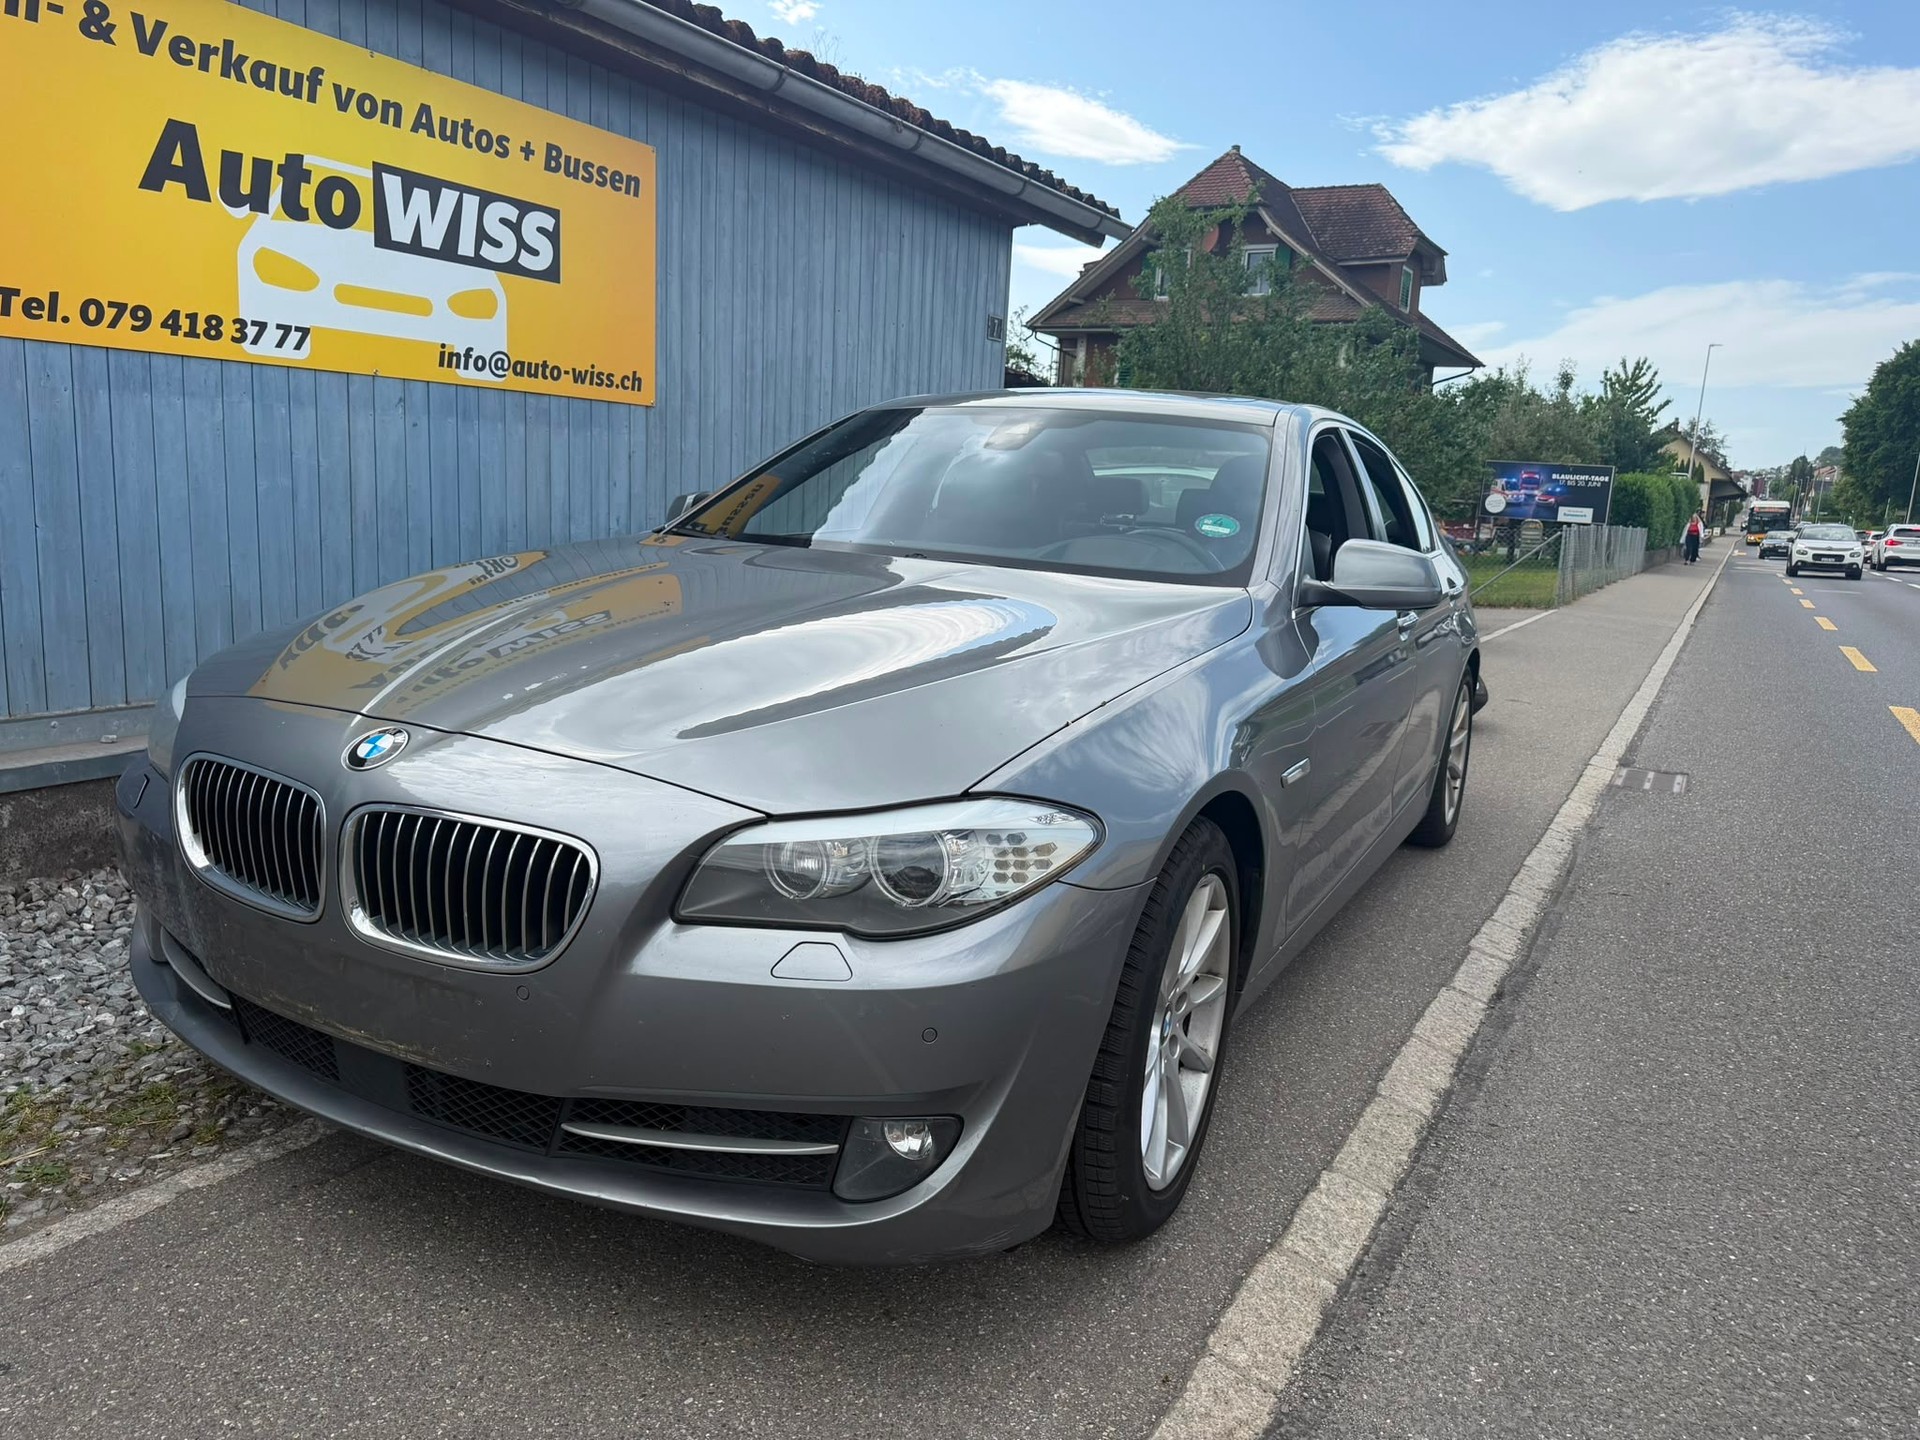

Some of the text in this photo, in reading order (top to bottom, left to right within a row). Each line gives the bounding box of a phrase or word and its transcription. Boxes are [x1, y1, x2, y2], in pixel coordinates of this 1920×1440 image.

[78, 0, 117, 46] &
[129, 10, 325, 104] Verkauf
[332, 82, 403, 128] von
[410, 102, 511, 159] Autos
[520, 140, 535, 161] +
[544, 142, 641, 198] Bussen
[138, 117, 556, 272] Auto WISS
[0, 285, 311, 351] Tel. 079 418 37 77
[438, 342, 643, 392] info@auto-wiss.ch
[1552, 474, 1609, 482] BLAULICHT-TAGE
